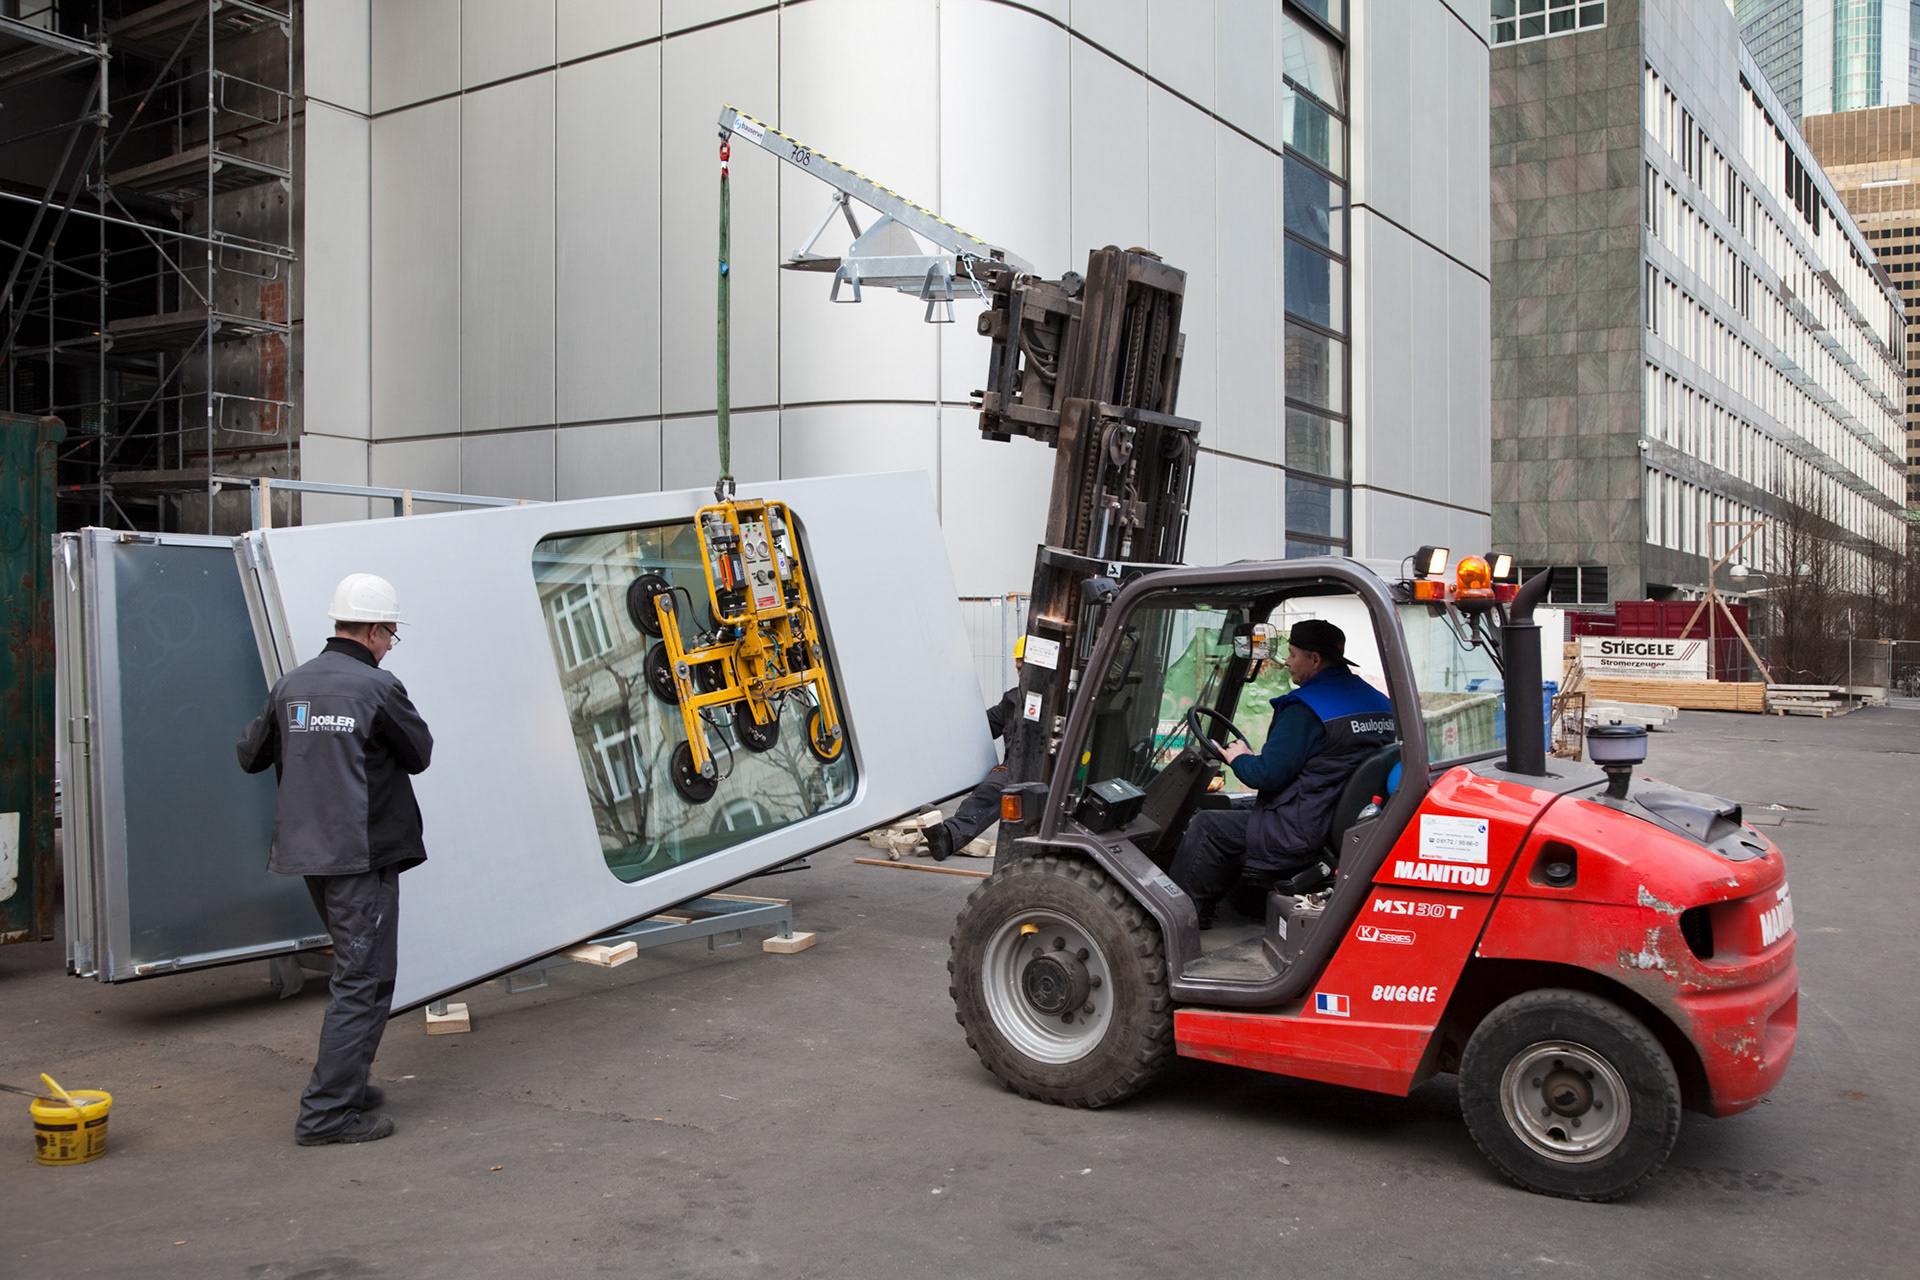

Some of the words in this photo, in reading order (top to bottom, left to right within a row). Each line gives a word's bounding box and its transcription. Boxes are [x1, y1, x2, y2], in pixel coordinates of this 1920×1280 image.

[791, 144, 811, 166] 708
[1600, 659, 1666, 669] Stromerzeuger
[310, 715, 355, 728] DOBLER
[1394, 860, 1491, 886] MANITOU
[1380, 933, 1412, 943] SERIES
[1371, 984, 1438, 1002] BUGGIE
